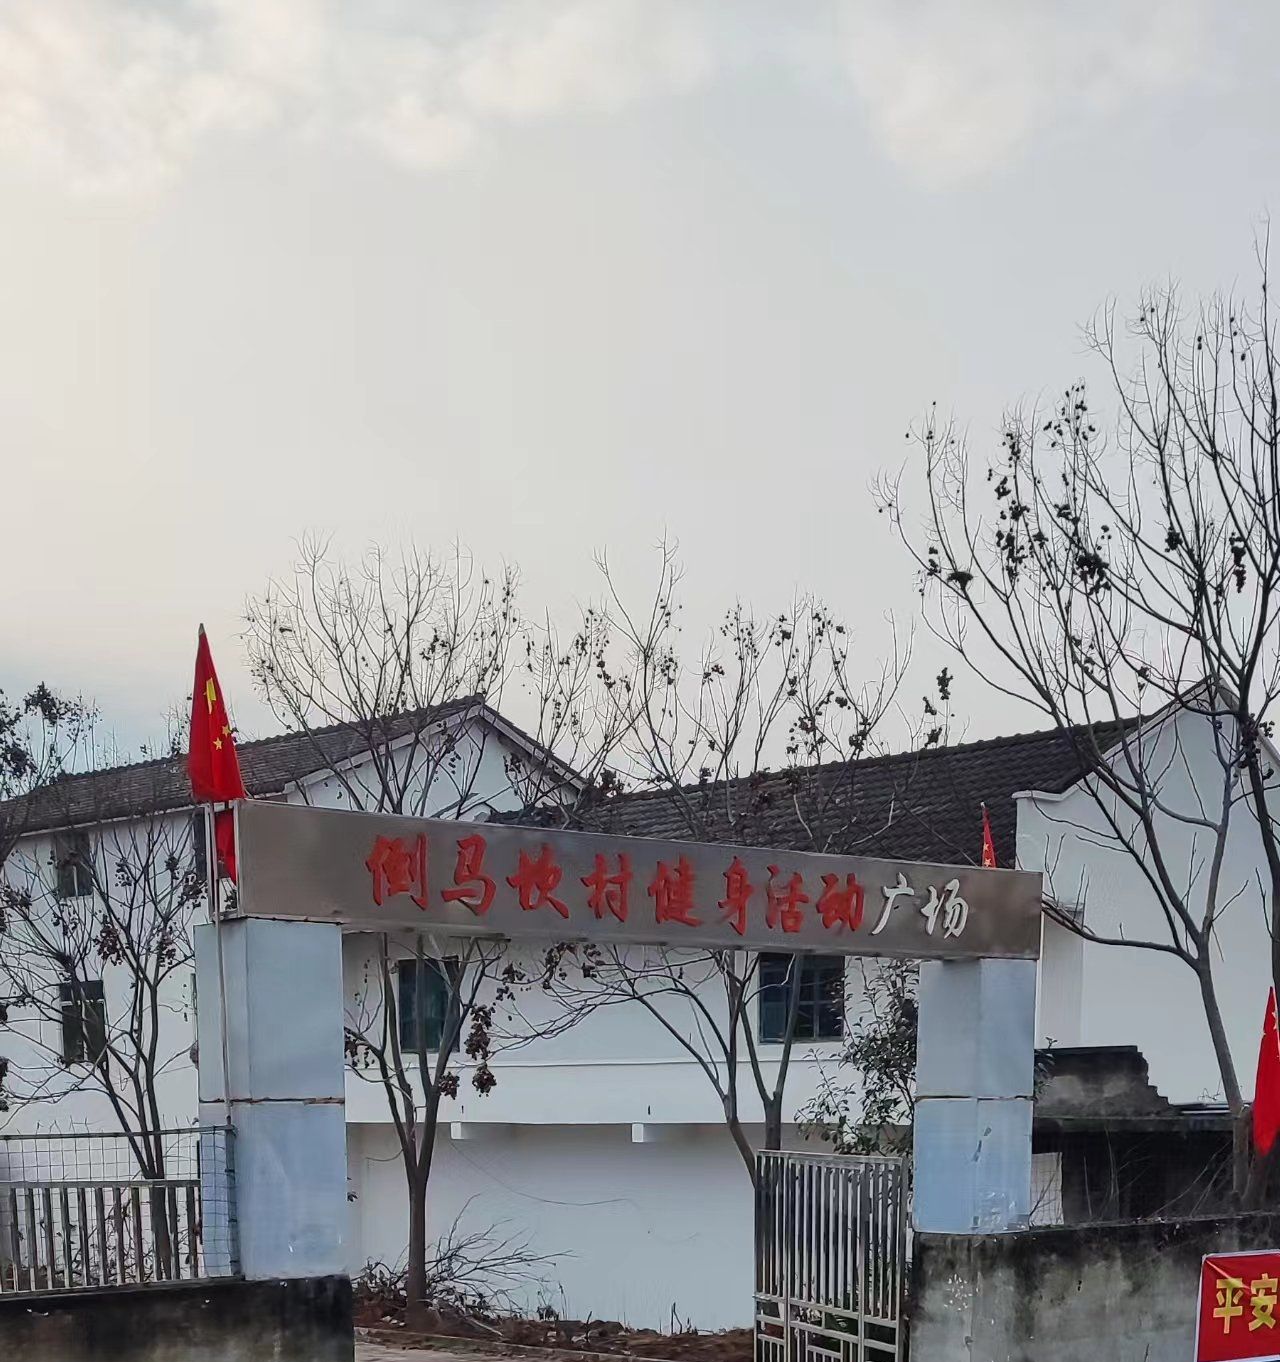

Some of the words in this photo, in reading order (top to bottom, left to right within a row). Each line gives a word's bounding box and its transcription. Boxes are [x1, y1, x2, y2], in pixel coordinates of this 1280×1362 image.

[365, 832, 969, 939] 倒马坎村健身活动广场
[1213, 1273, 1279, 1334] 平安
